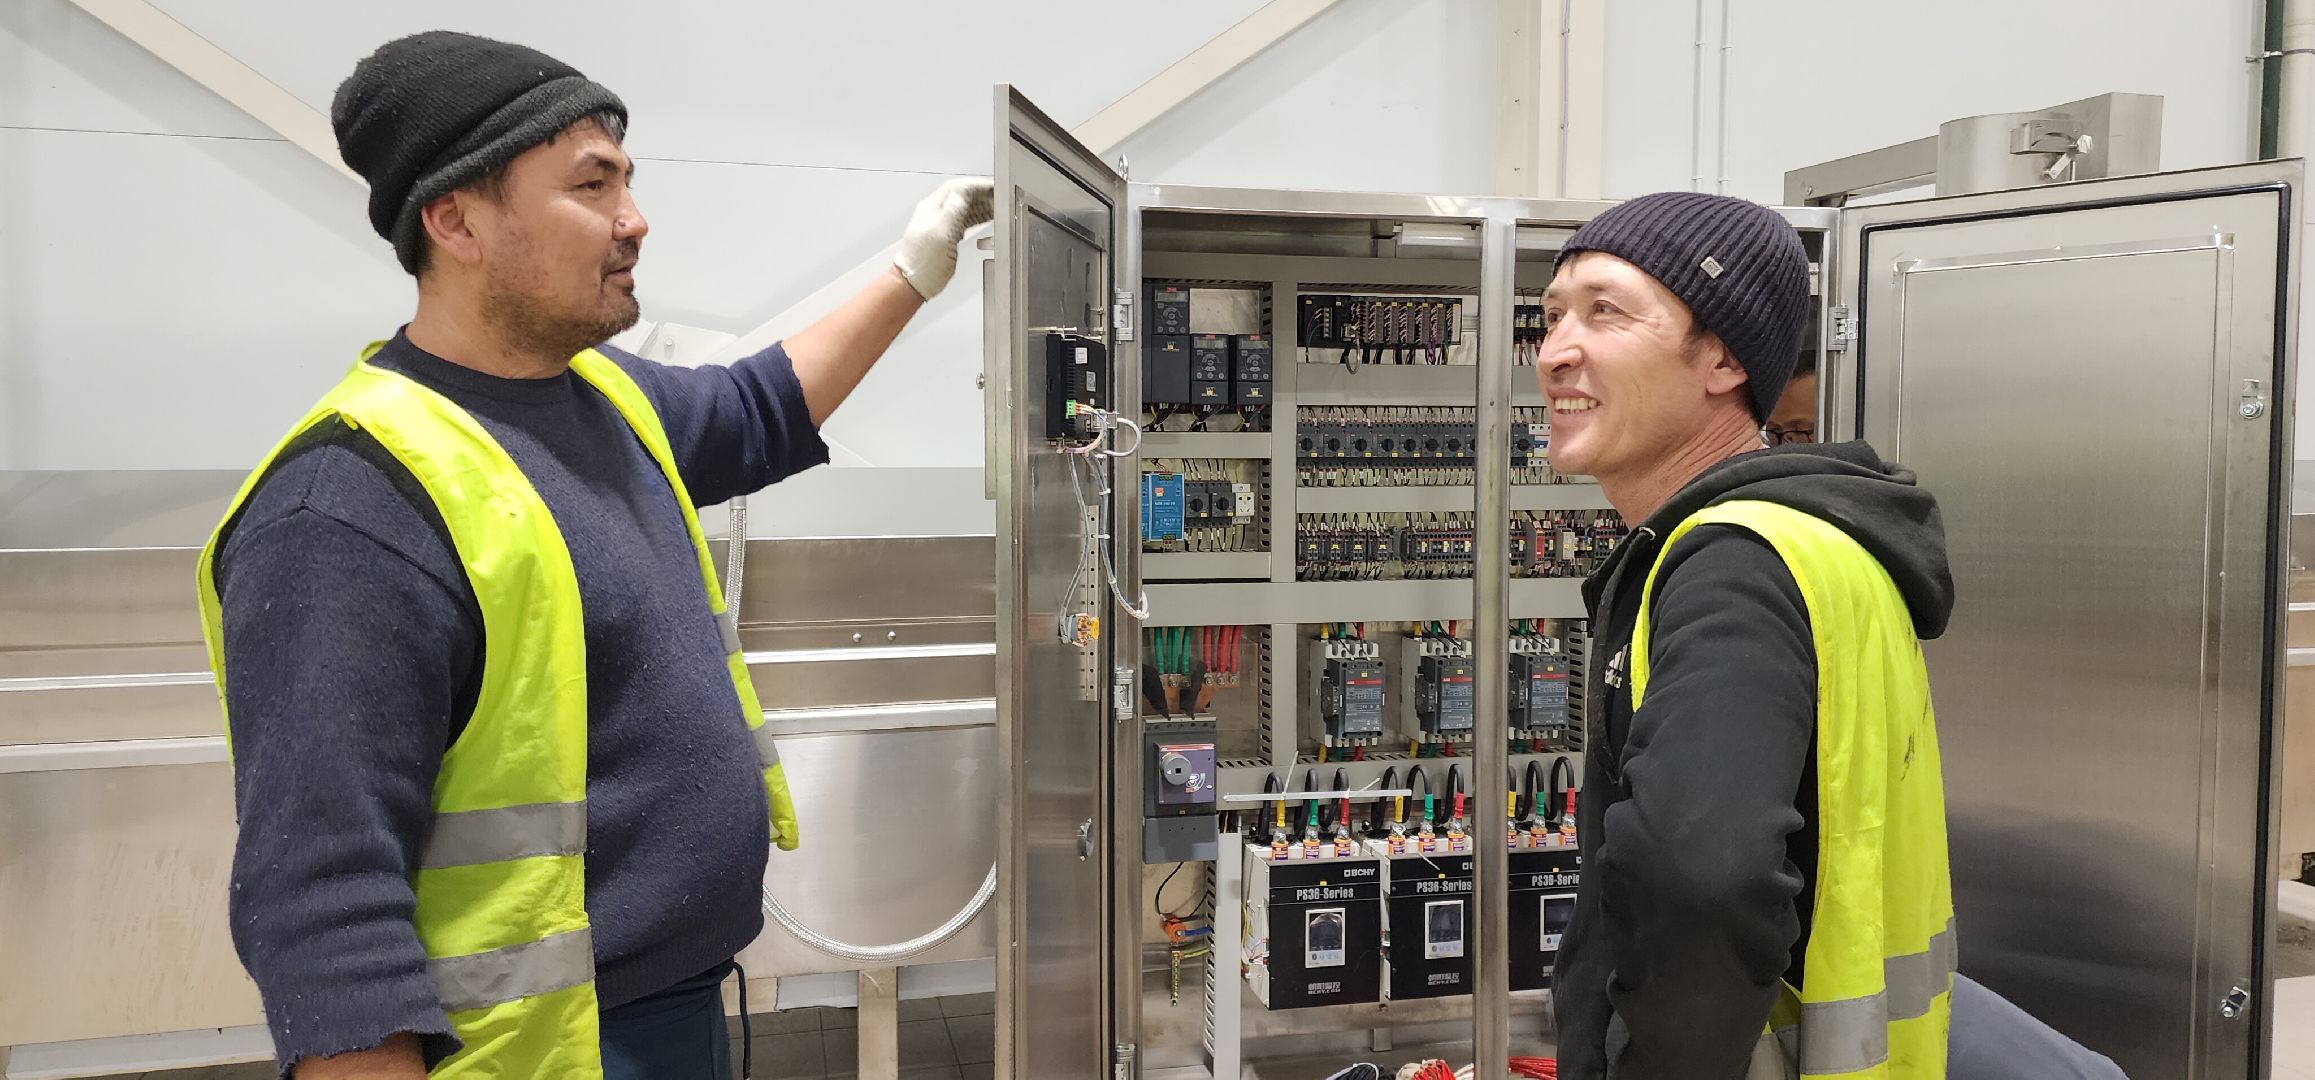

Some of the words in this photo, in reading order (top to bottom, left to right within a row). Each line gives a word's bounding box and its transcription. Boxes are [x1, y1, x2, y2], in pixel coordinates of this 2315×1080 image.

[1351, 868, 1375, 877] BCHY
[1531, 873, 1580, 887] PS36-Serie
[1296, 886, 1354, 901] PS36-Series
